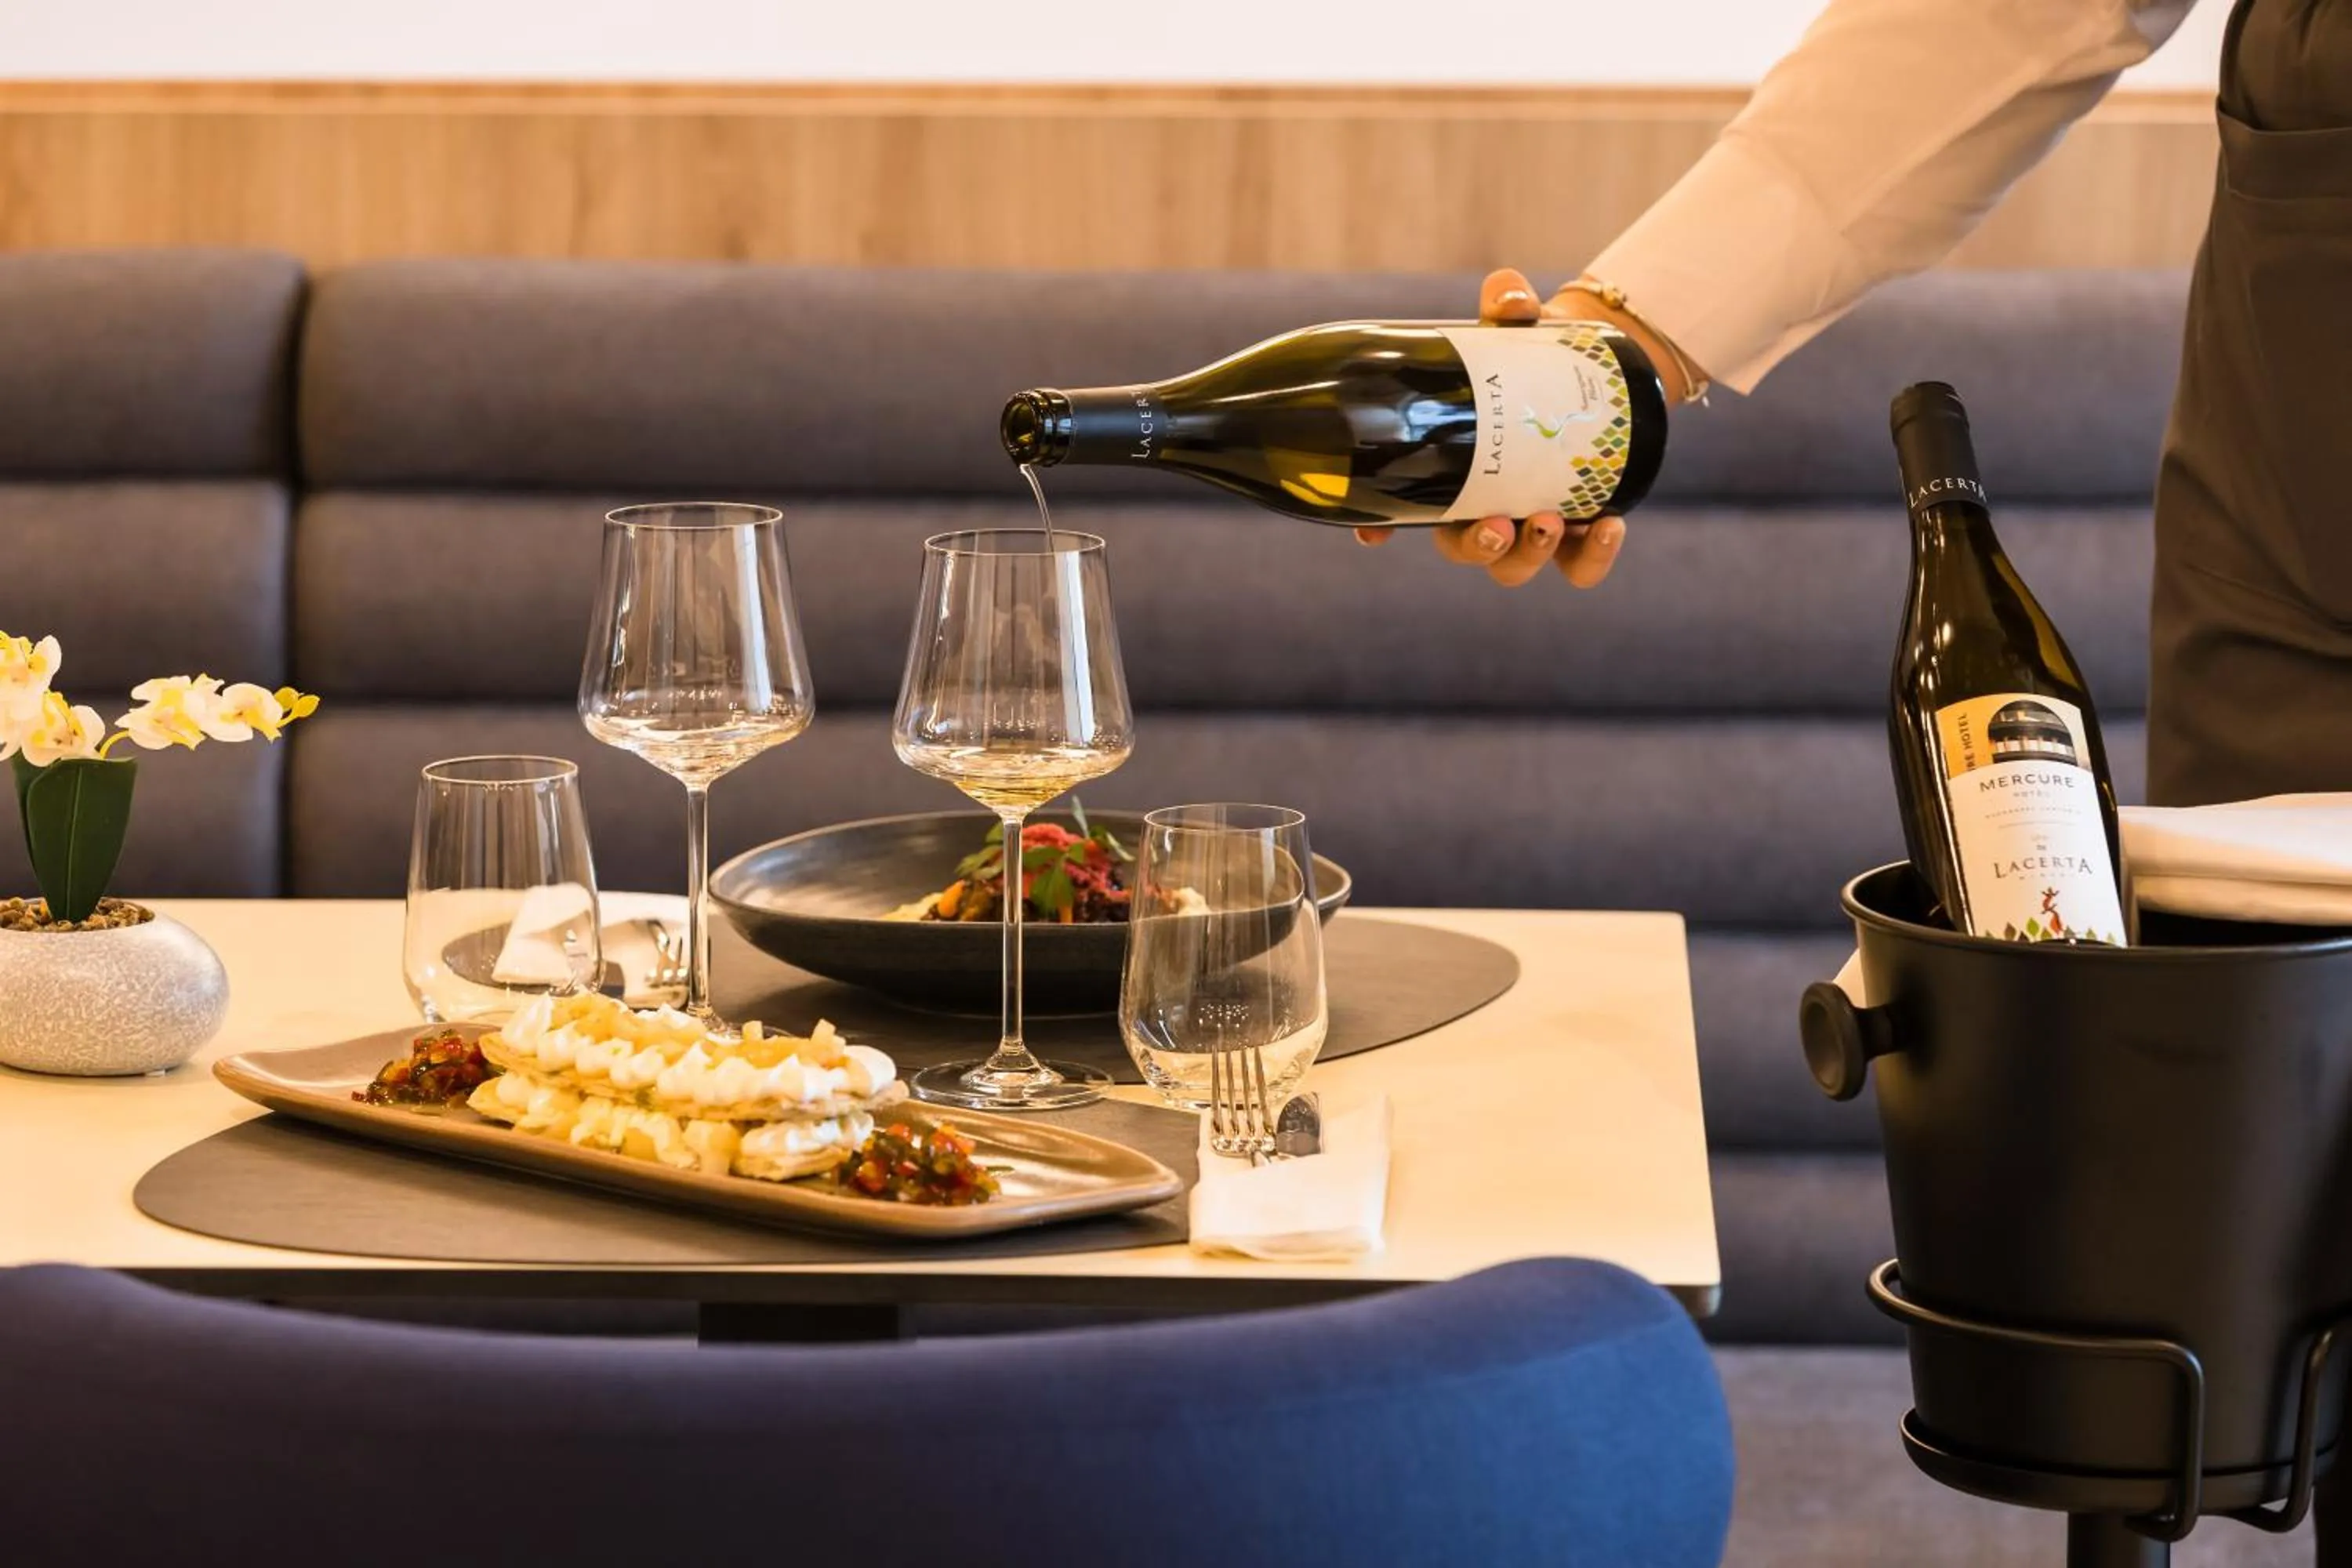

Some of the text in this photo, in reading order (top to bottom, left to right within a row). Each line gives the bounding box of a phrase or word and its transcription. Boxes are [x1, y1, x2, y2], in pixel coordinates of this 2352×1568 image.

[1484, 373, 1504, 475] LACERTA
[1958, 712, 1973, 750] HOTEL
[1980, 774, 2075, 793] MERCURE
[1994, 857, 2093, 879] LACERTA
